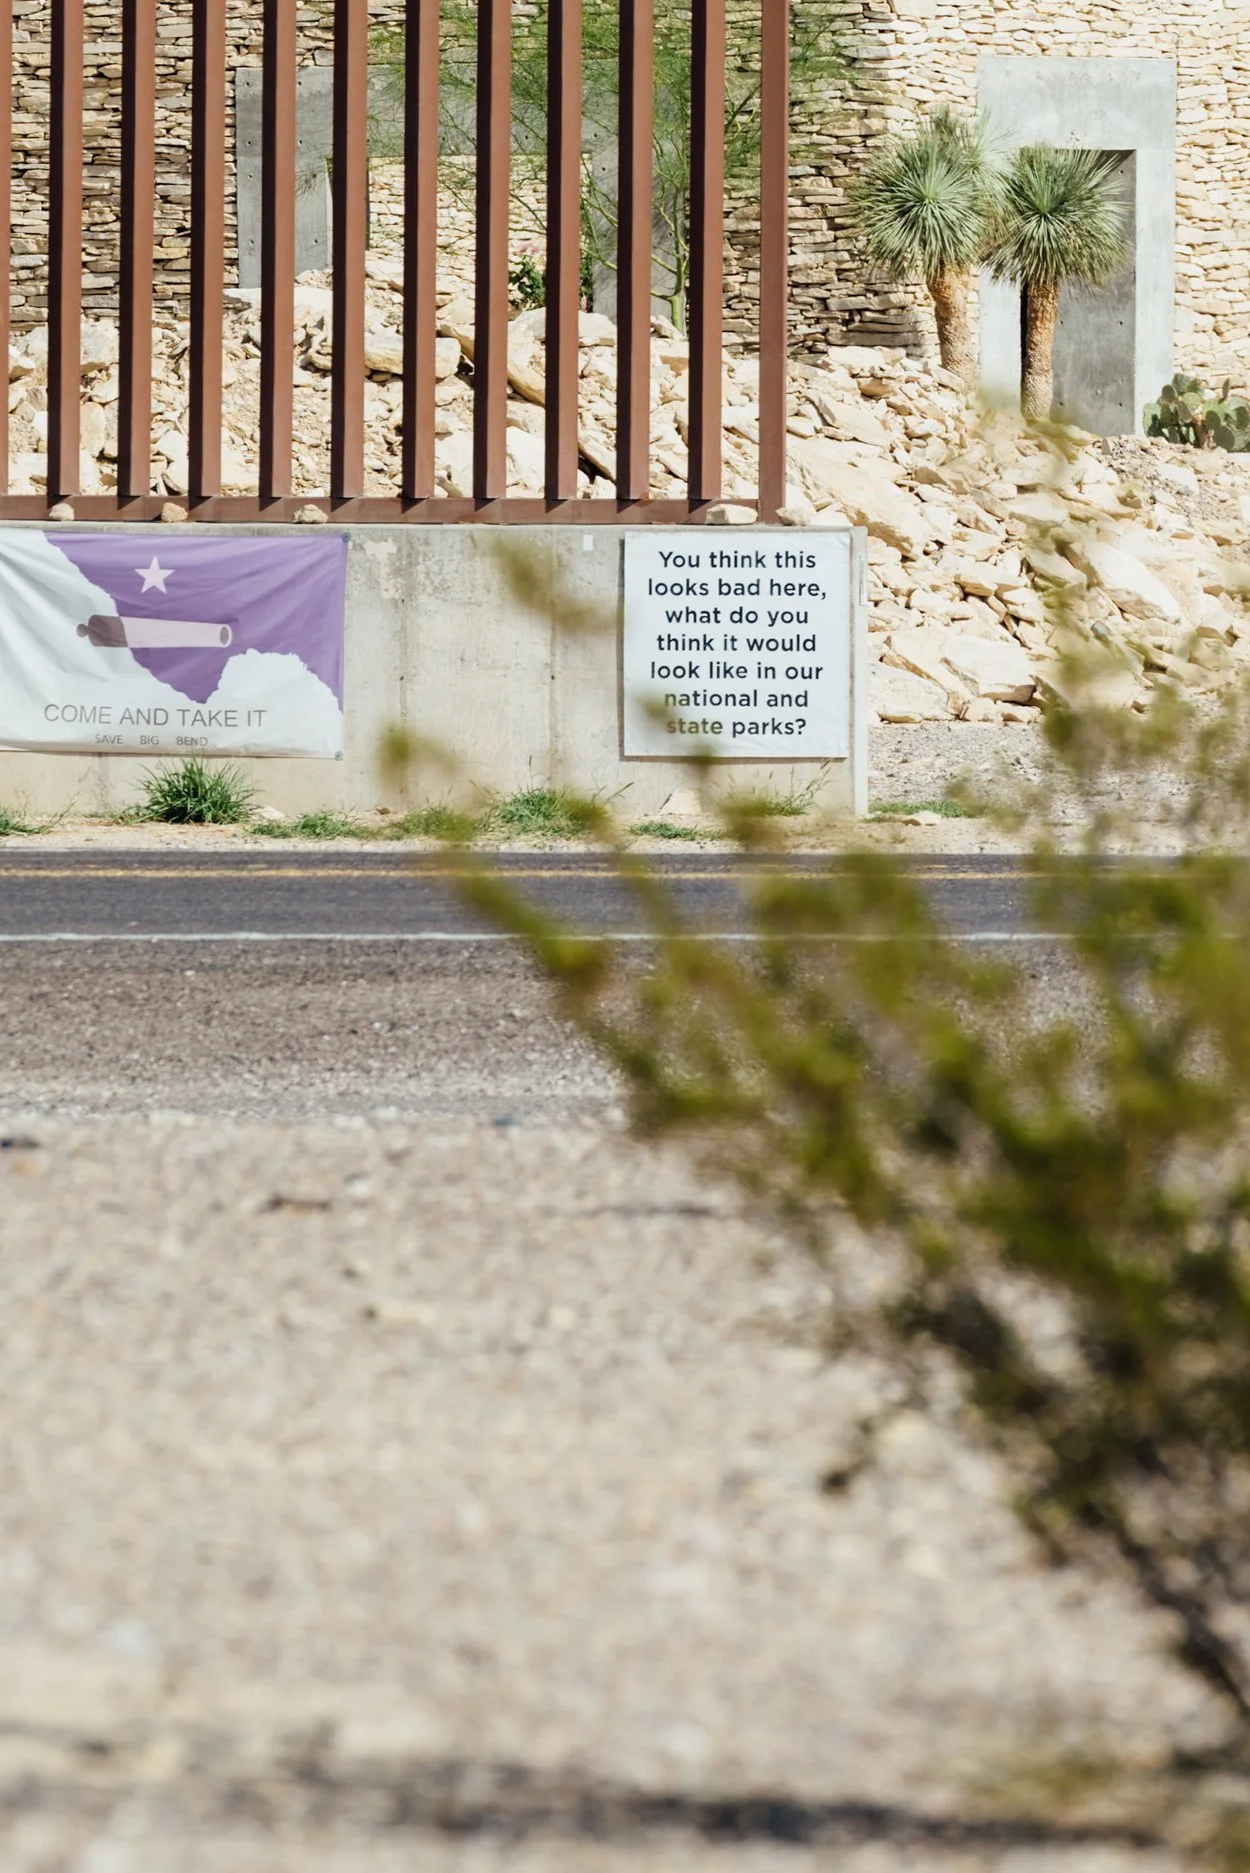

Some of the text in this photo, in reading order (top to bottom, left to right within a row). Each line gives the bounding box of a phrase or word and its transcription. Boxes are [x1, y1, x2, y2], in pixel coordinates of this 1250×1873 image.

[658, 550, 816, 569] You think this
[648, 578, 826, 600] looks bad here,
[665, 606, 808, 628] what do you
[656, 633, 816, 652] think it would
[651, 661, 823, 680] look like in our
[664, 690, 808, 708] national and
[44, 703, 267, 728] COME AND TAKE IT
[666, 717, 807, 739] state parks?
[95, 734, 208, 747] SAVE BIG BEND
